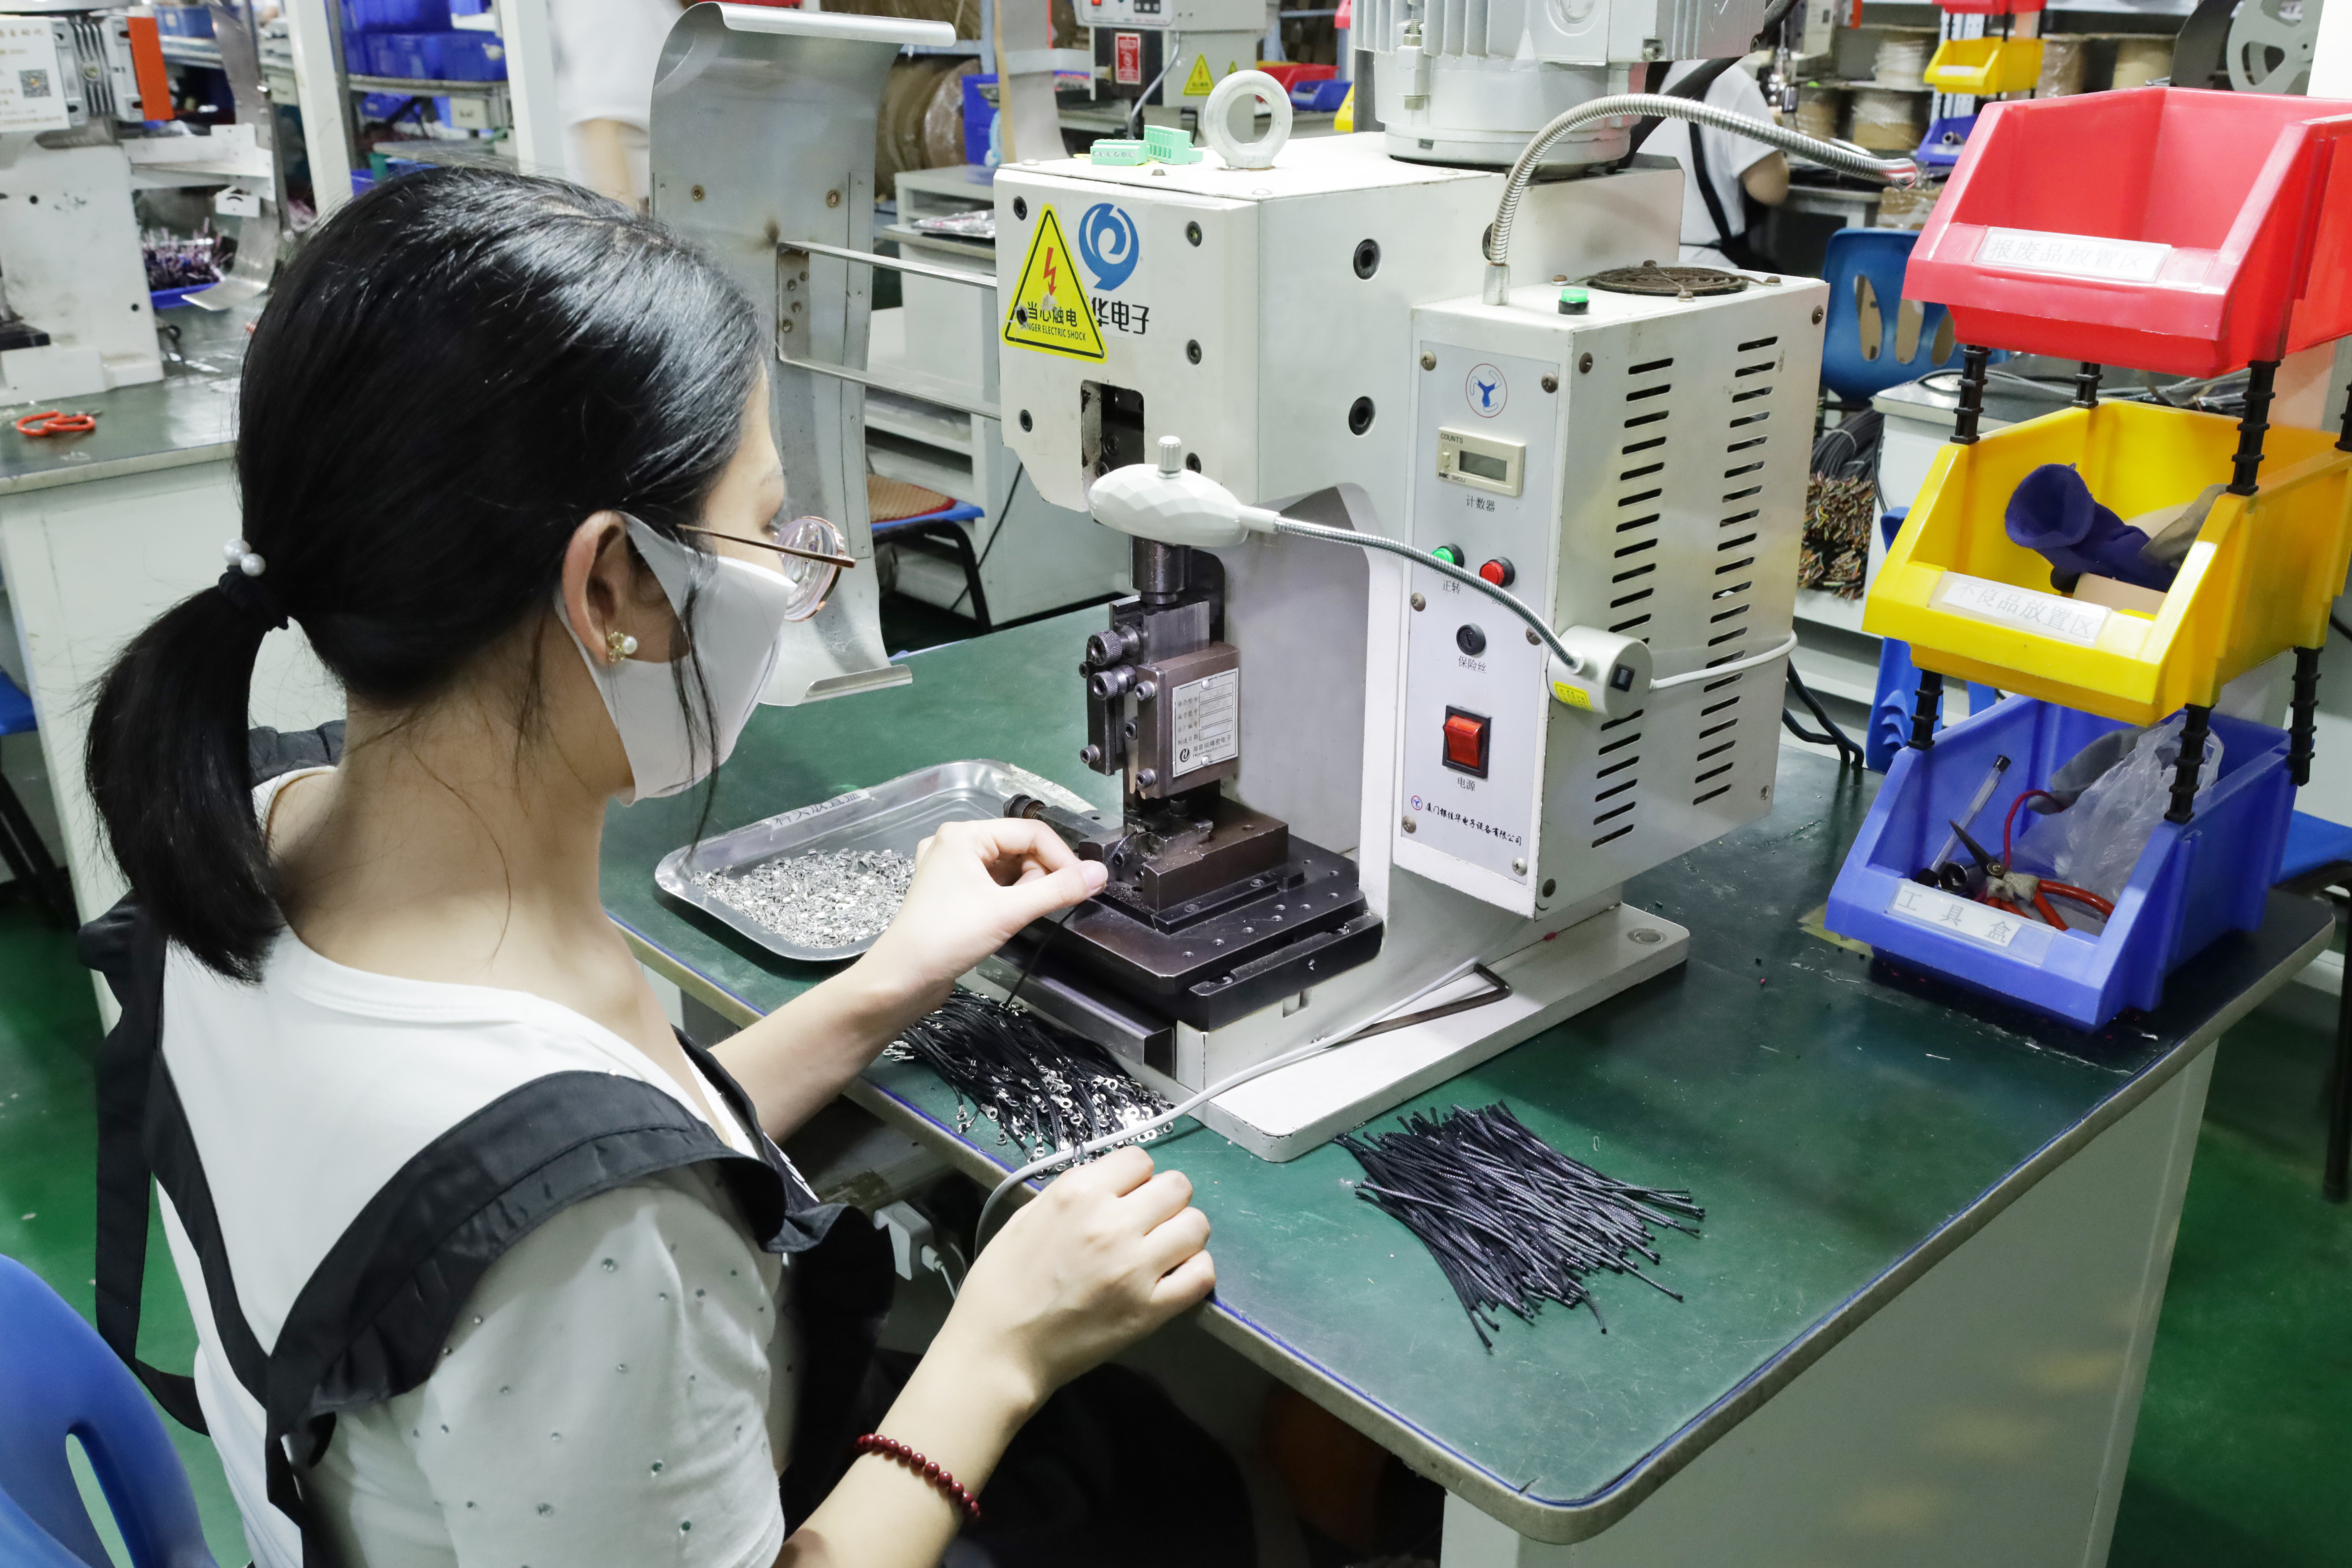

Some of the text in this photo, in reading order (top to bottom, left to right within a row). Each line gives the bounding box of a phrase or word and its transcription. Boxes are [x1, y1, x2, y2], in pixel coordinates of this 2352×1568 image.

[1988, 239, 2147, 273] 报废品放置区
[1028, 301, 1078, 327] 当心触电
[1087, 297, 1150, 335] 华电子
[1020, 323, 1086, 341] NGER ELECTRIC SHOCK
[1441, 433, 1463, 444] COUNTS
[1466, 494, 1495, 512] 计数器
[1442, 580, 1461, 594] 正转
[1955, 582, 2099, 639] 不良品放置区
[1458, 655, 1487, 674] 保险丝
[1178, 721, 1198, 733] 出厂编号
[1178, 734, 1199, 746] 制造日期
[1457, 776, 1476, 792] 电源
[1426, 802, 1522, 846] 厦门银佳华电子设备有限公司
[1897, 890, 2012, 943] 工具盒
